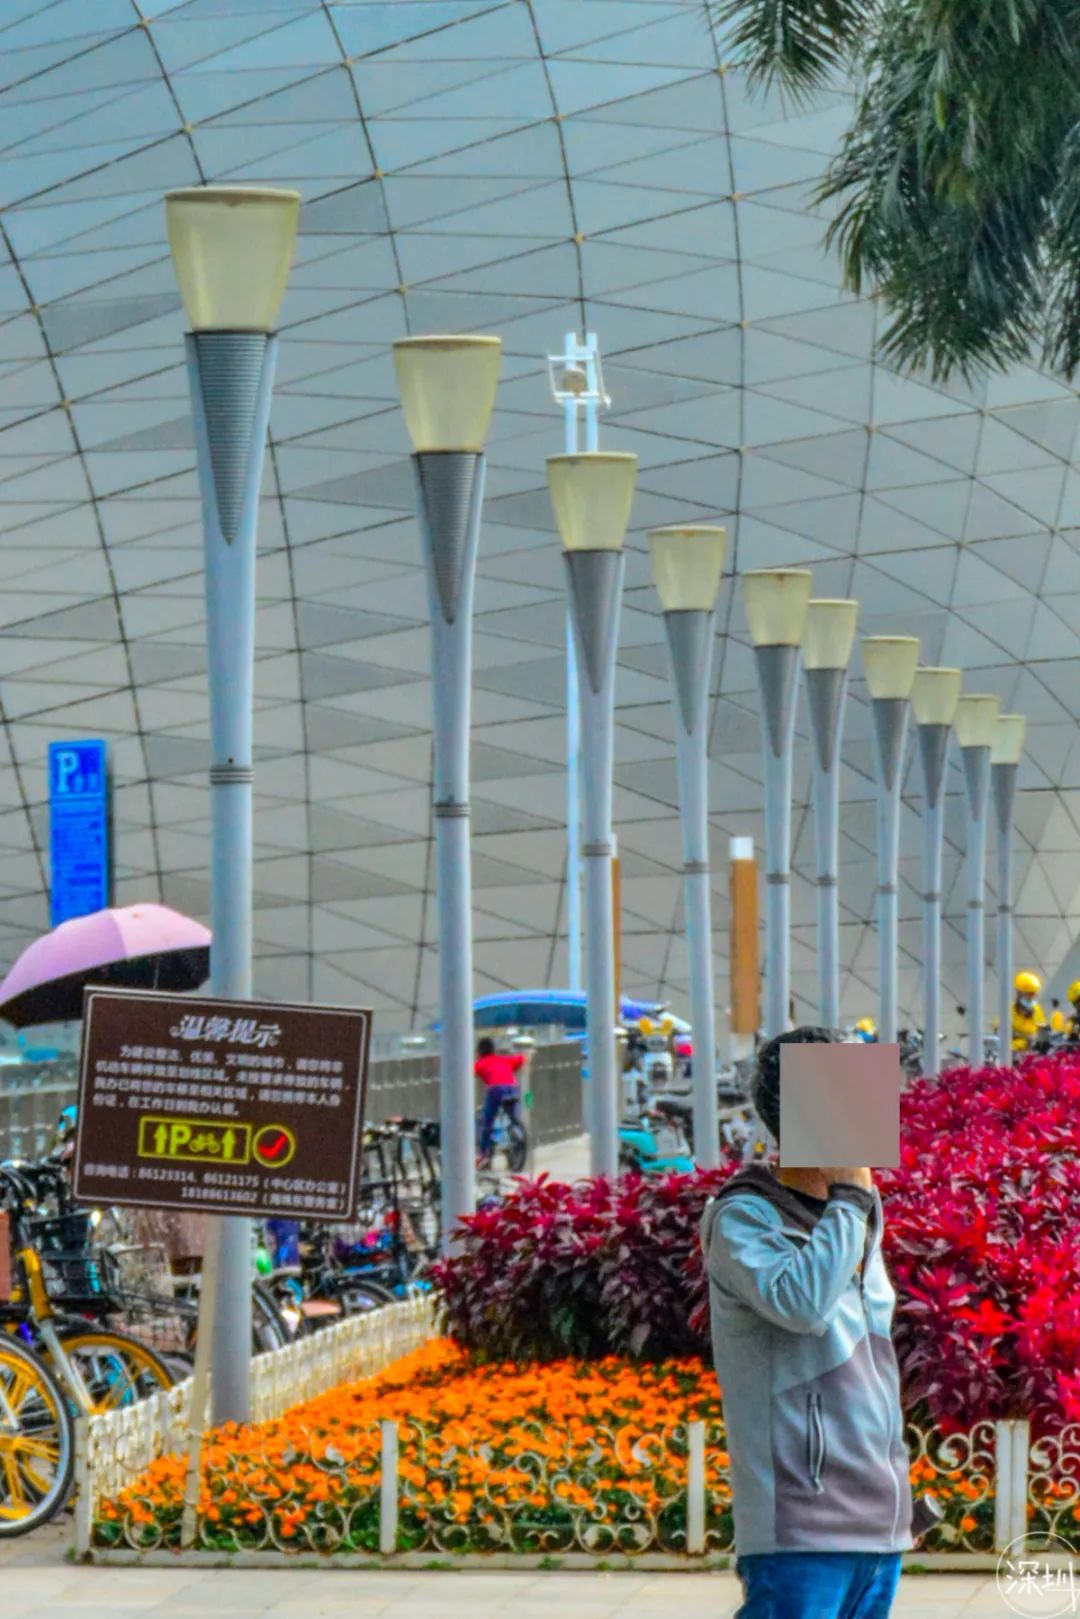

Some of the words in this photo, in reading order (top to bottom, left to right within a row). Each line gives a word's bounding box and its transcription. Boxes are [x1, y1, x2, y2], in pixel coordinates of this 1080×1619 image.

[170, 1012, 281, 1048] 温馨提示
[168, 1124, 192, 1155] P
